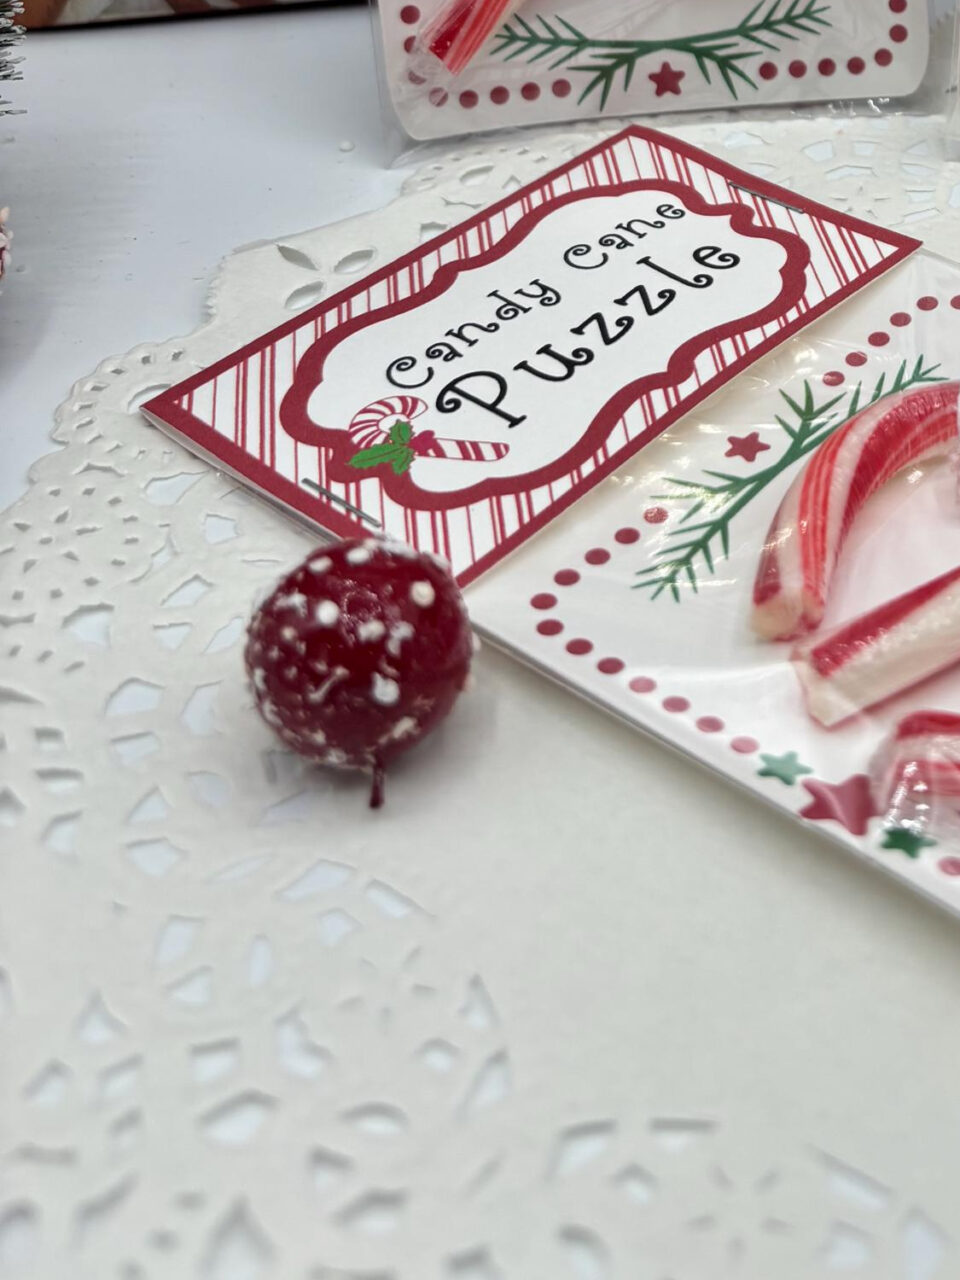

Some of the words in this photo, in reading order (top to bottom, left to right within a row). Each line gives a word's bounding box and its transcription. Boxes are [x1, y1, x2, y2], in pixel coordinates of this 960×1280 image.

[385, 278, 561, 389] Candy
[563, 203, 686, 270] Cane
[435, 245, 741, 429] Puzzle
